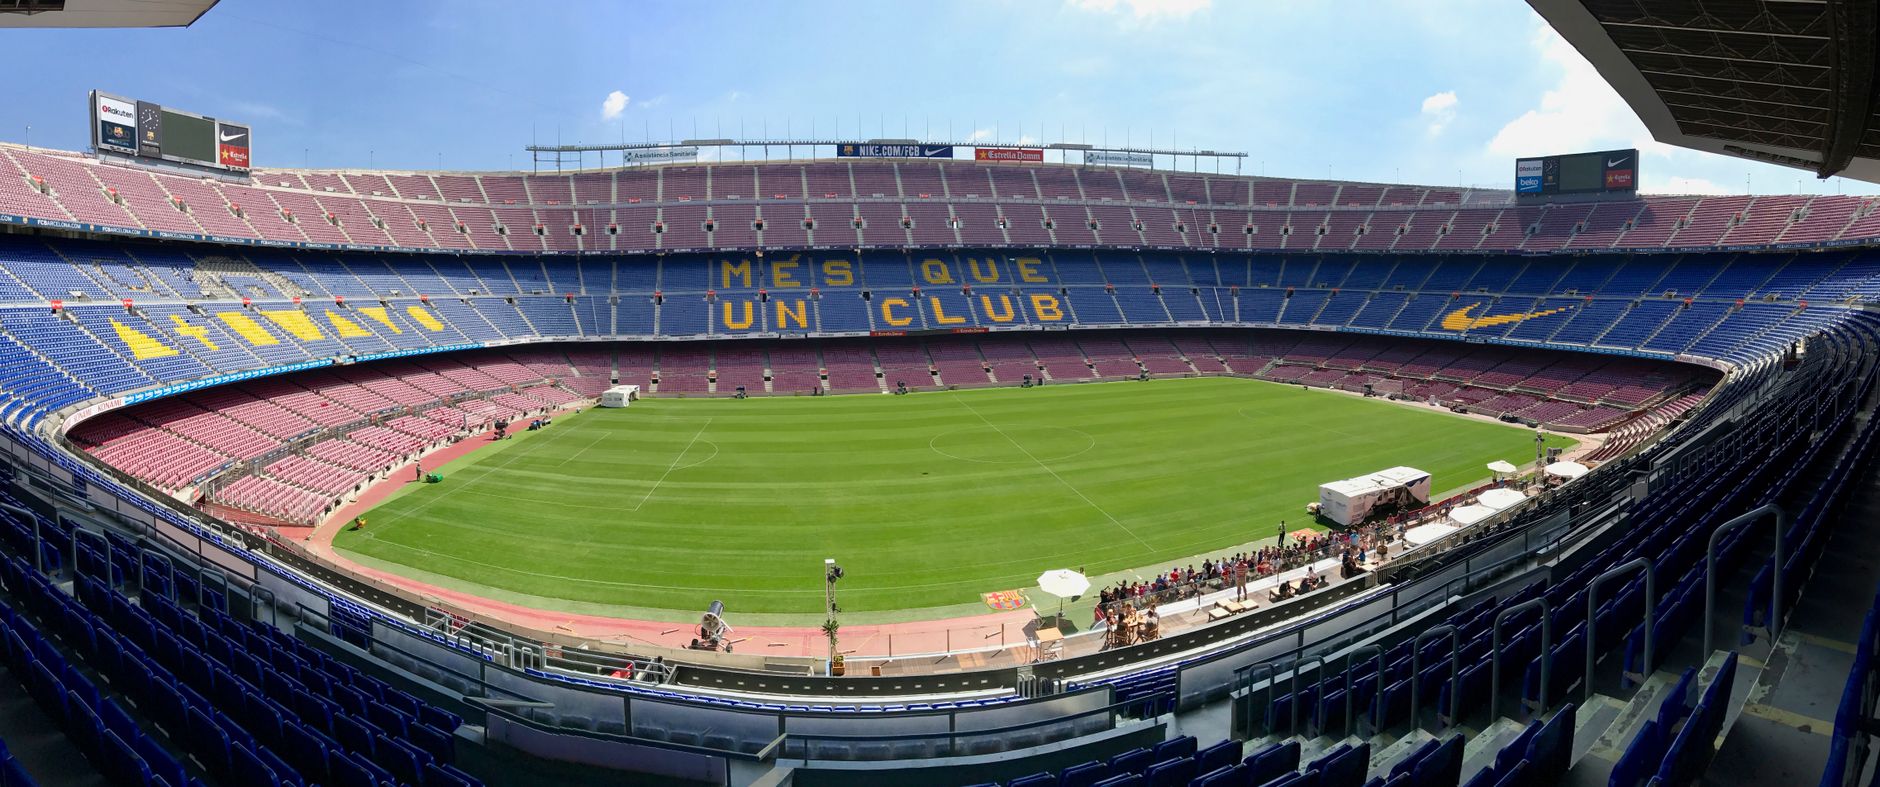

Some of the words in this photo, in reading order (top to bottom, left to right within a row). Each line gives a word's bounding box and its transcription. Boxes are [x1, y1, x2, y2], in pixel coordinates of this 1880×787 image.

[107, 106, 134, 119] Rakuten
[859, 145, 920, 157] NIKE.COM/FCB
[988, 150, 1016, 160] Estrella
[1017, 151, 1041, 160] Damm
[1520, 178, 1539, 186] beko
[721, 253, 854, 289] MÉS
[921, 257, 1049, 285] QUE
[723, 299, 808, 330] UN
[881, 294, 1065, 327] CLUB
[97, 399, 123, 412] KONAMI
